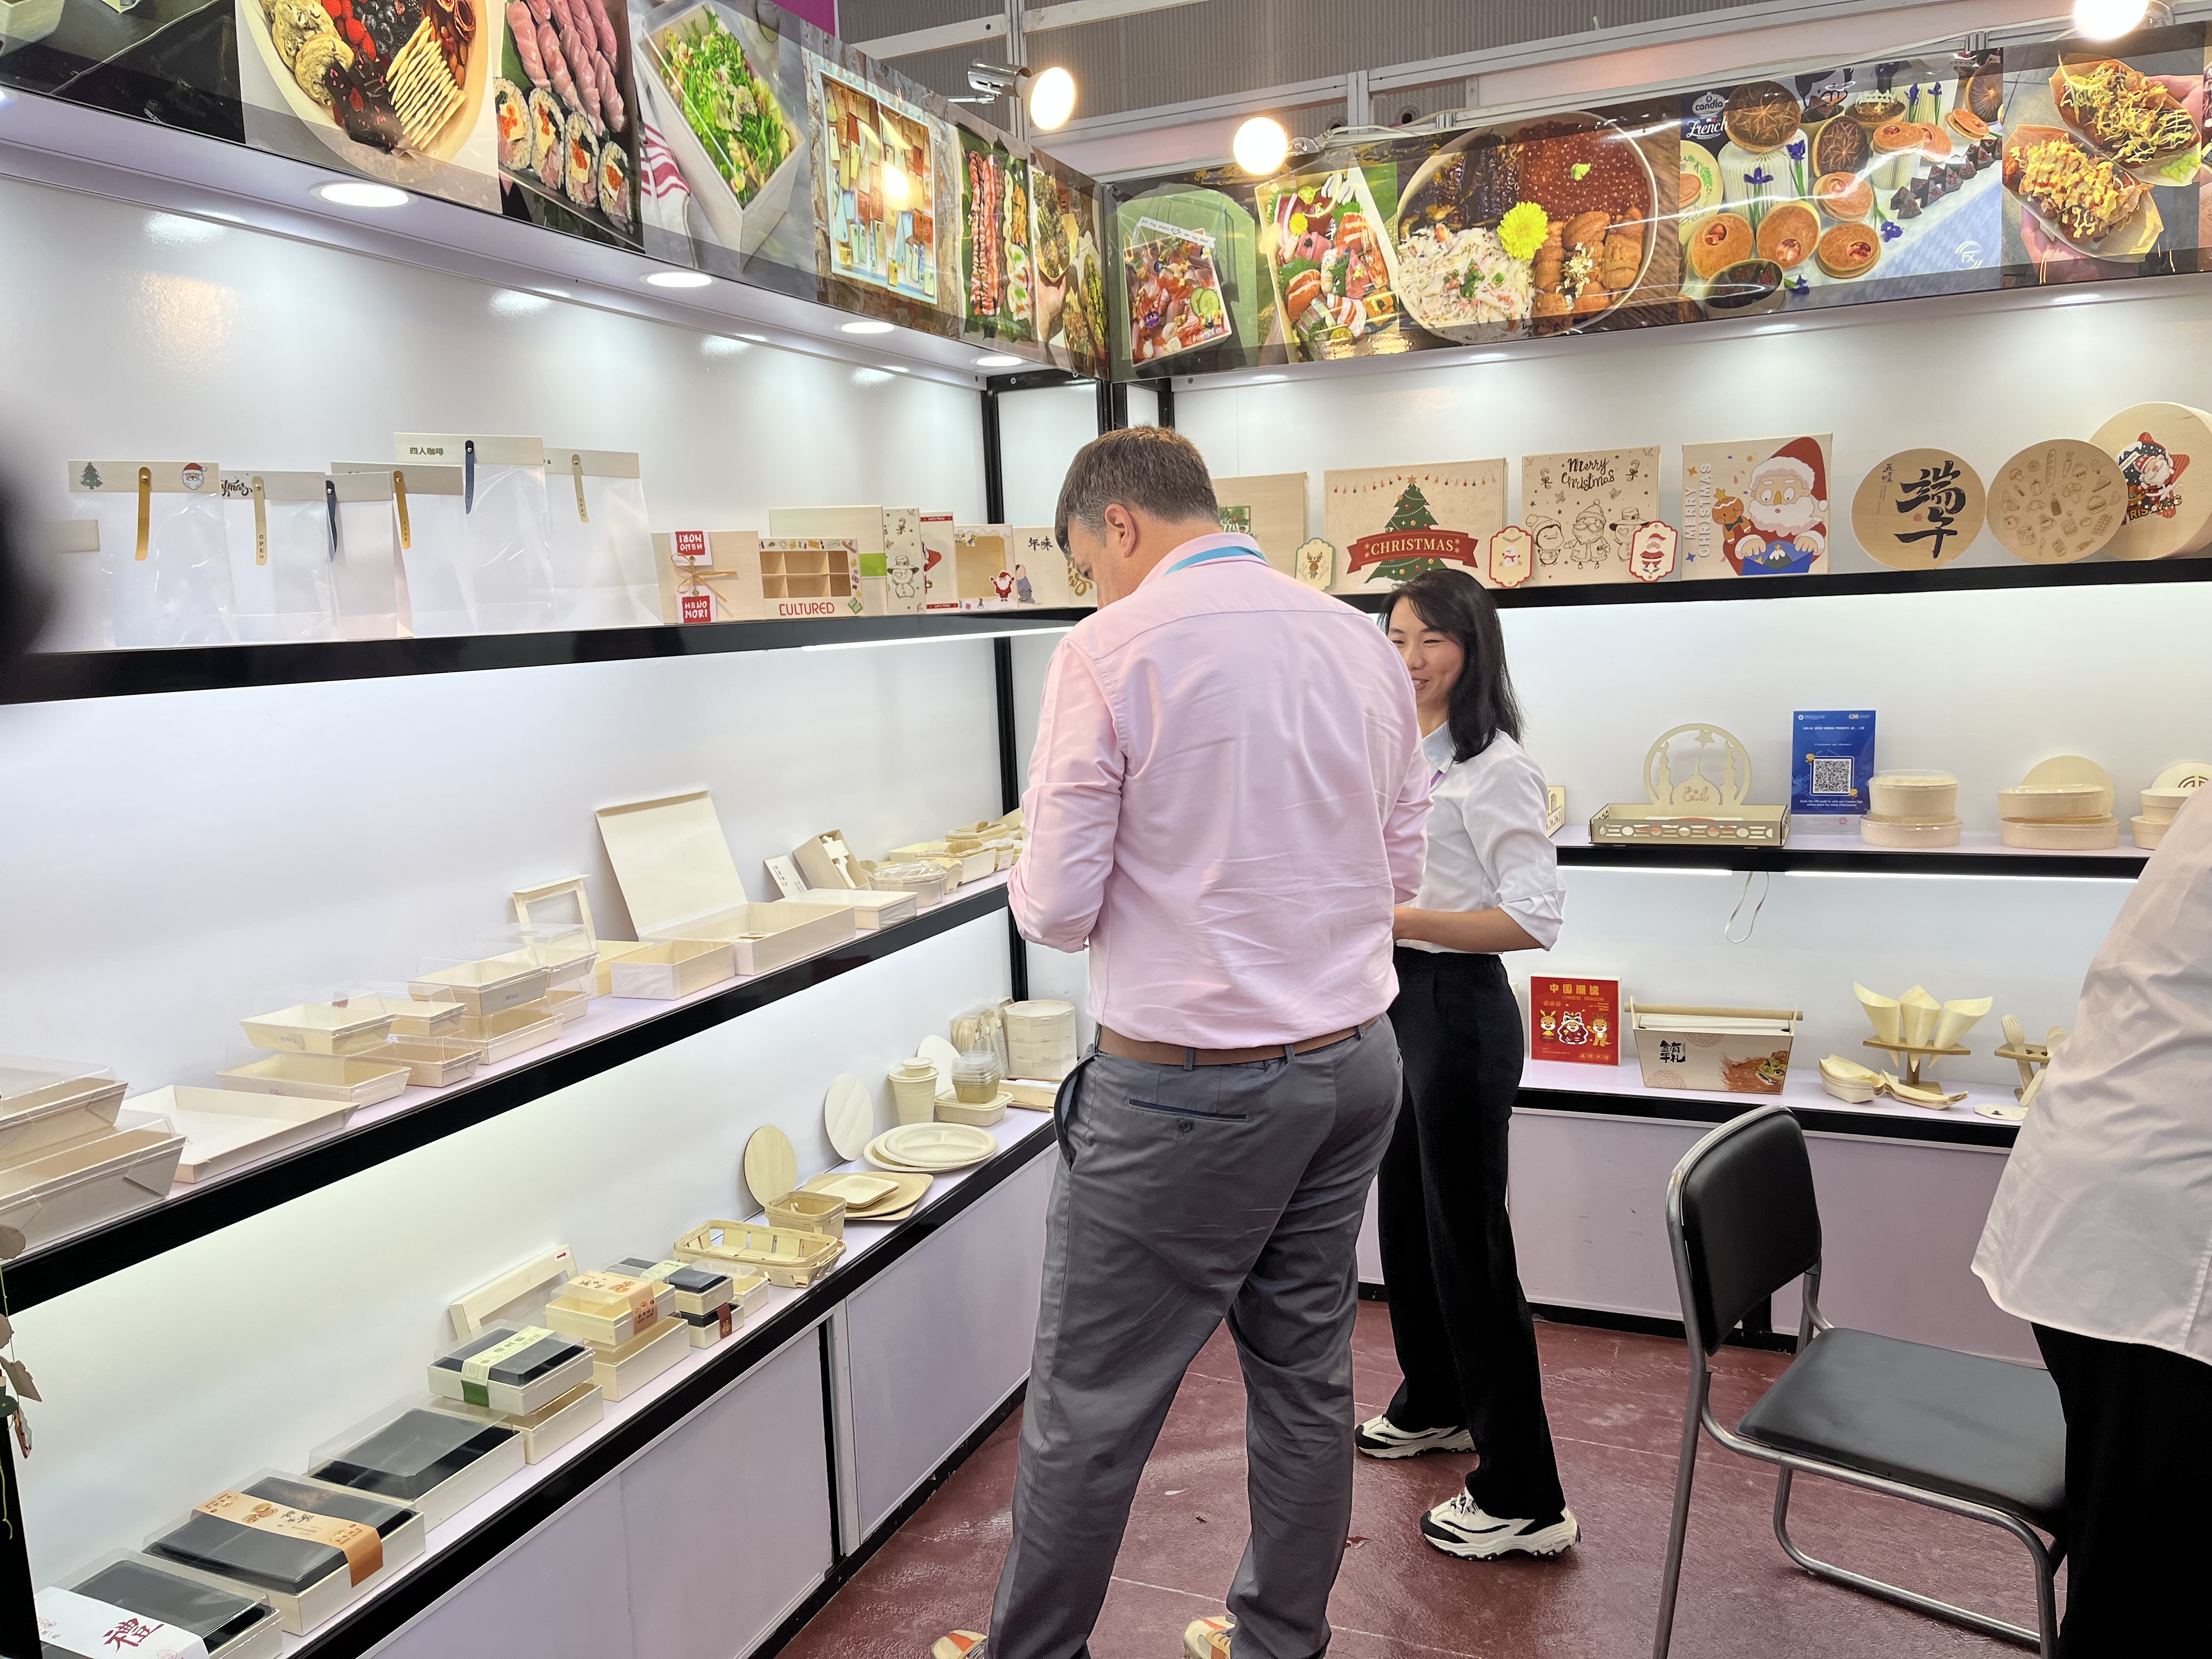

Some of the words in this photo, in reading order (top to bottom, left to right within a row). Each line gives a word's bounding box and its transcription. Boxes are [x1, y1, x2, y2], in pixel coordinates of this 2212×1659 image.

[1695, 100, 1723, 111] candia
[1686, 115, 1729, 138] French
[1567, 458, 1610, 475] Merry
[1561, 469, 1615, 491] Christmas
[1685, 487, 1696, 540] MERRY
[1699, 463, 1711, 558] CHRISTMAS
[1893, 460, 1966, 559] 端午
[679, 534, 702, 543] NORI
[1370, 538, 1454, 555] CHRISTMAS
[685, 600, 707, 609] HELLO
[779, 602, 835, 616] CULTURED
[685, 609, 708, 619] NORI
[1683, 786, 1709, 802] Eid
